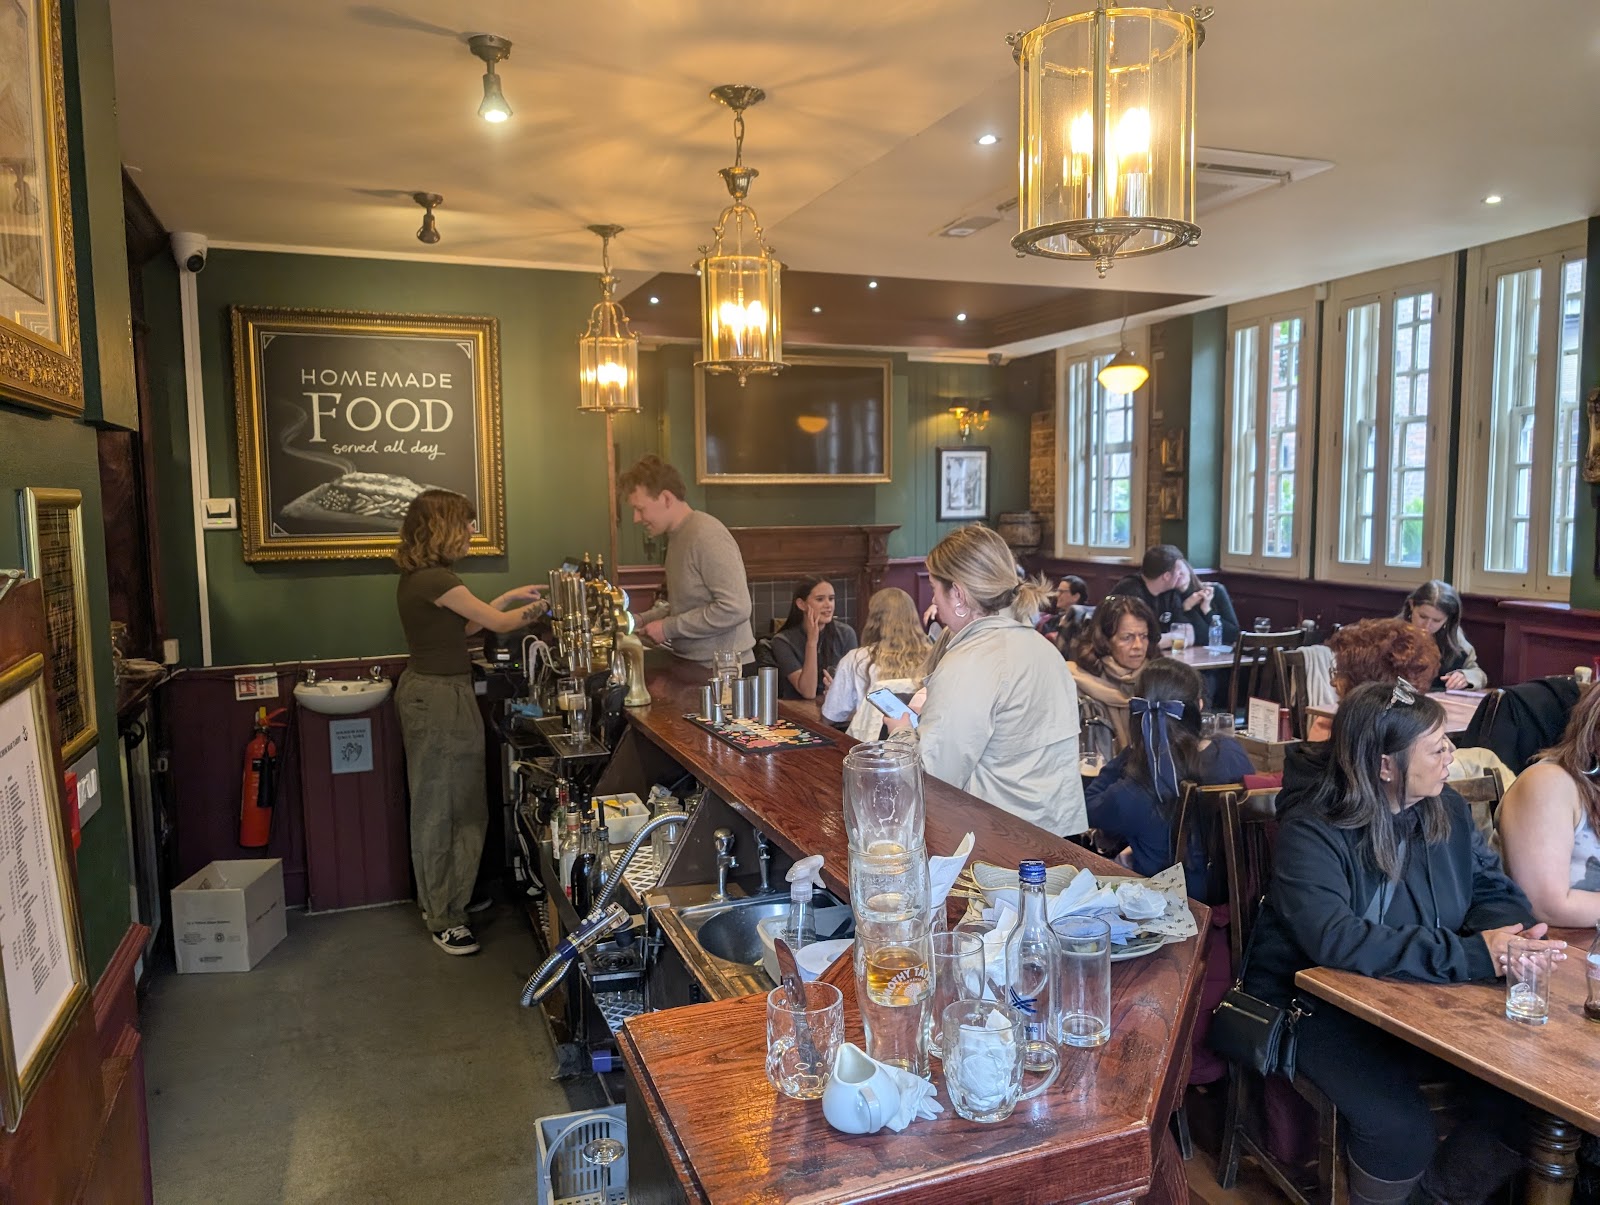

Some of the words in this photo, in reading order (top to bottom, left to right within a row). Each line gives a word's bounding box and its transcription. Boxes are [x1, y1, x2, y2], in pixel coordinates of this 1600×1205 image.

[301, 368, 453, 389] HOMEMADE
[302, 391, 454, 443] FOOD
[331, 439, 378, 455] served
[383, 439, 407, 455] all
[410, 440, 446, 461] day
